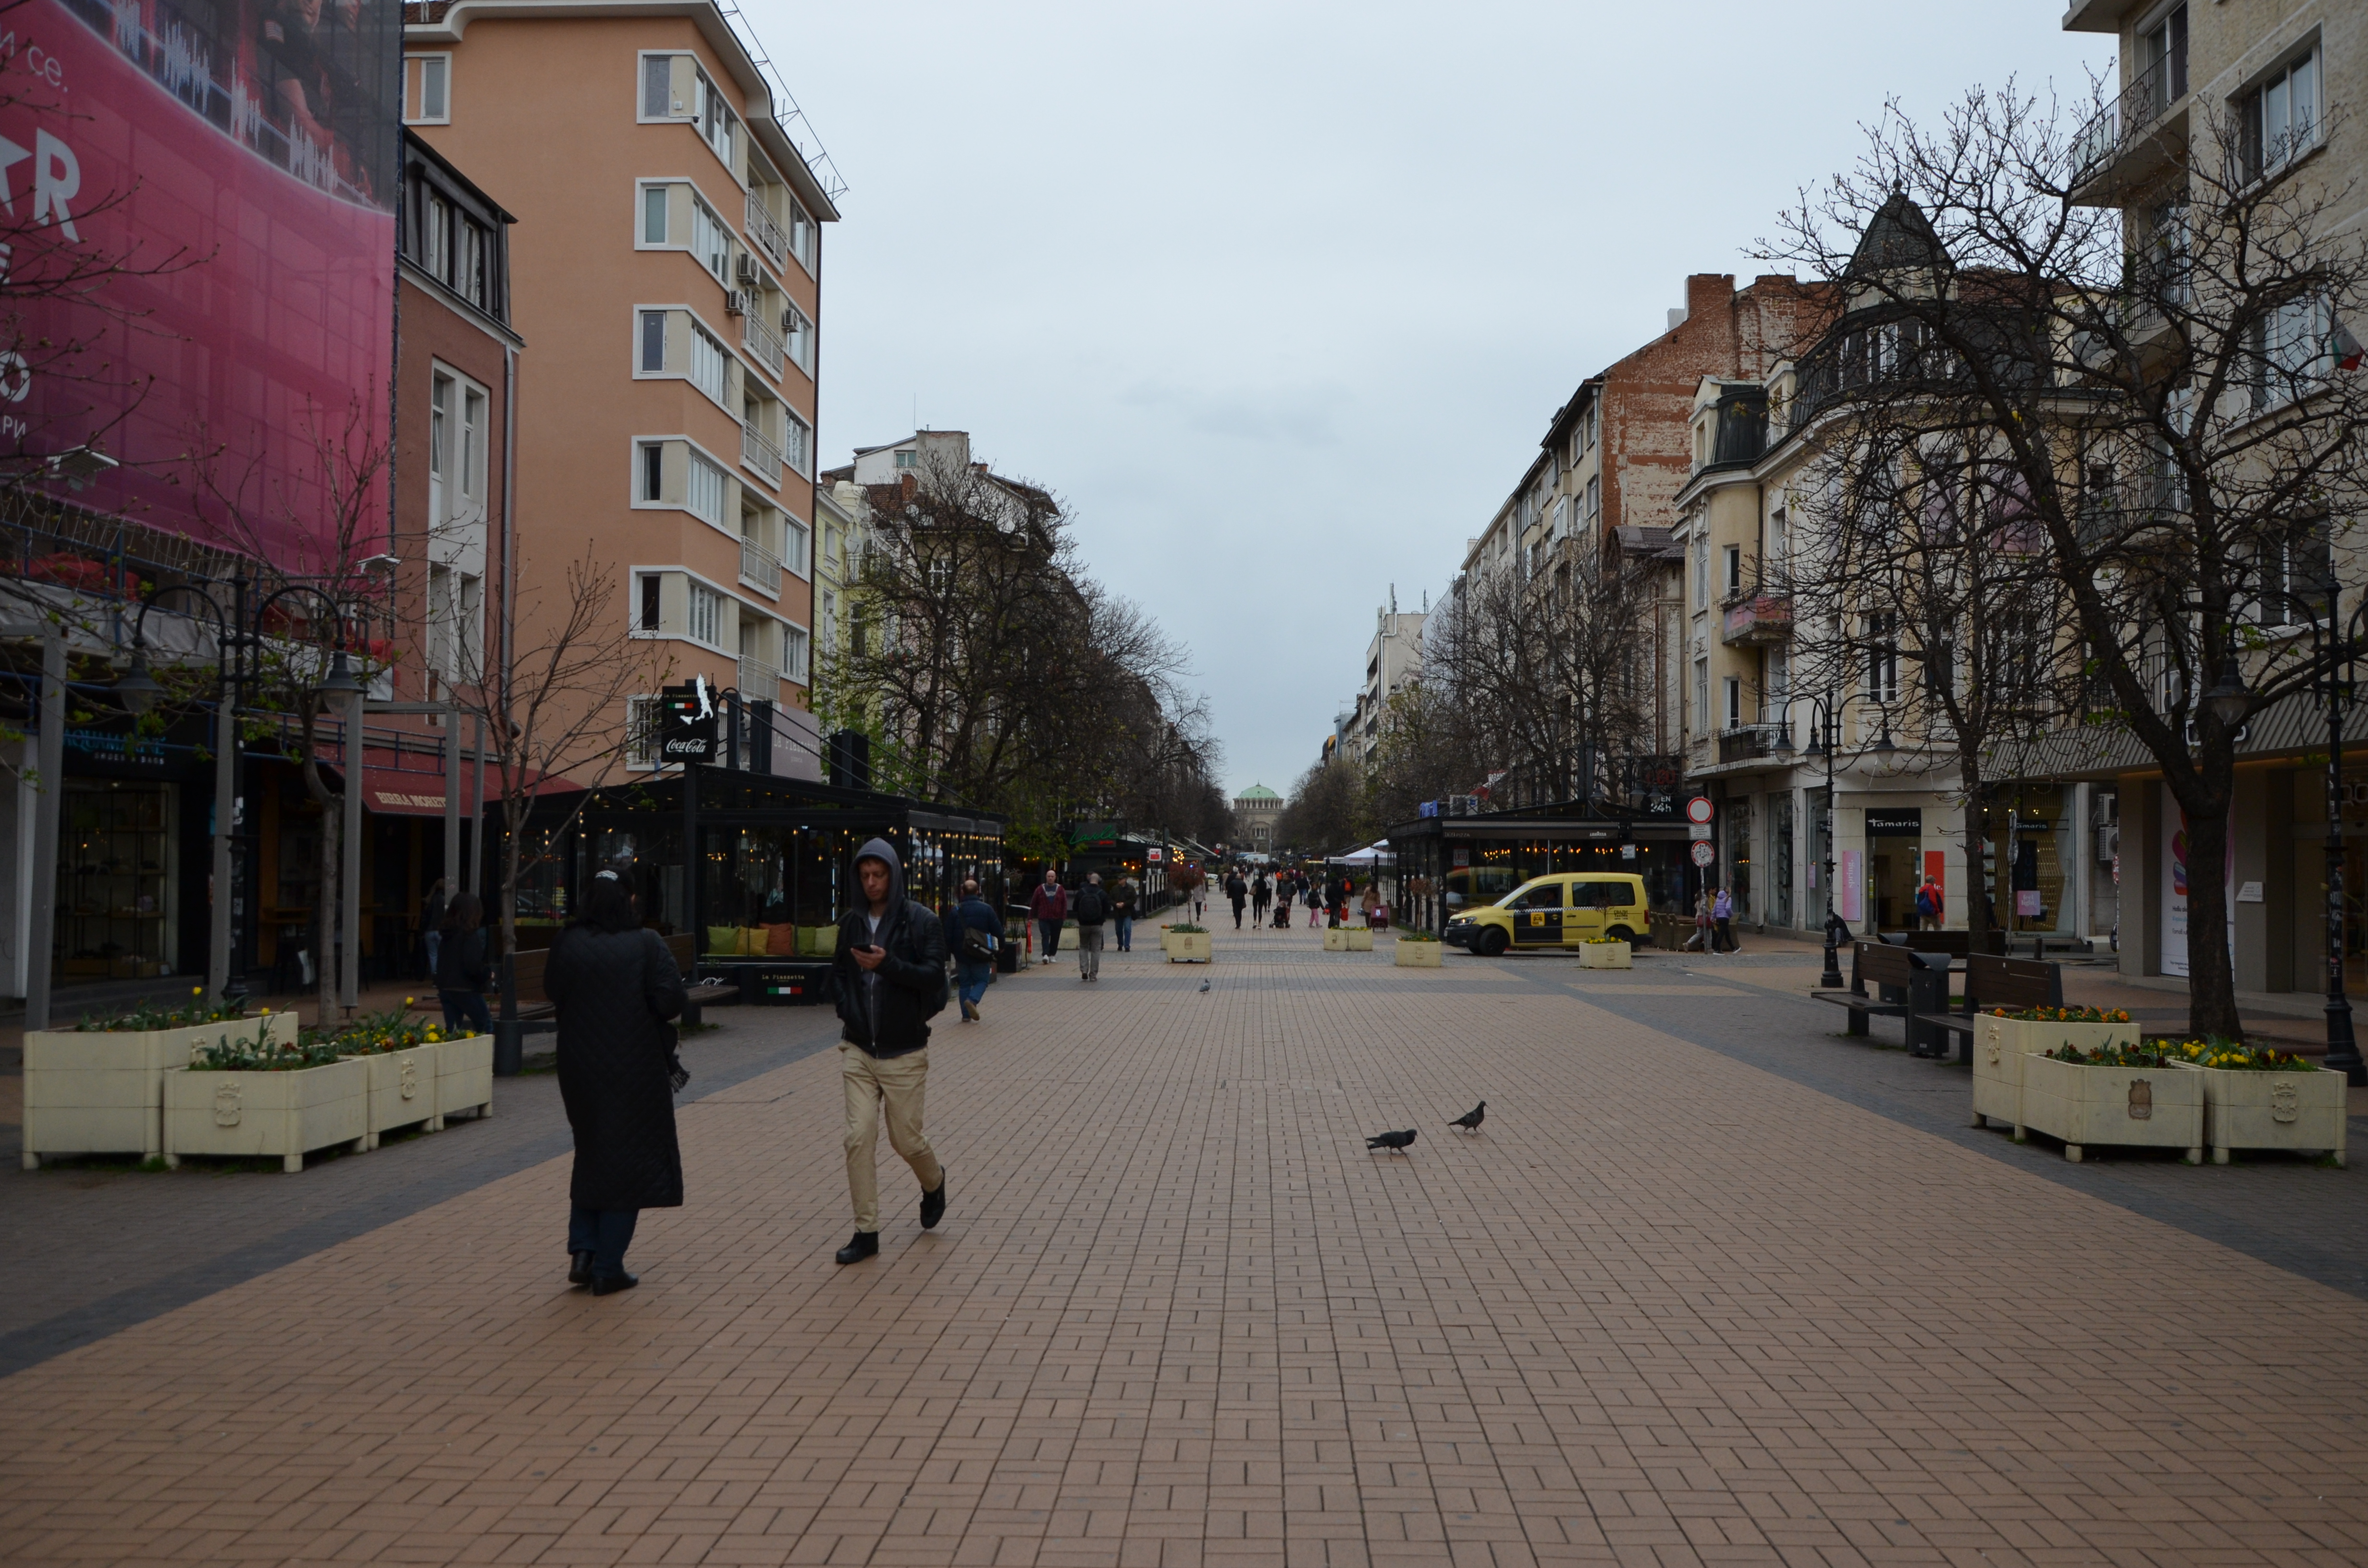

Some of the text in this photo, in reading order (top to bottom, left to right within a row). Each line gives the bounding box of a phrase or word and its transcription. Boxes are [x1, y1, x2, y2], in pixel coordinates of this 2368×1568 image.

[0, 415, 25, 438] РИ
[666, 738, 708, 753] Coca-Cola
[141, 756, 165, 765] BAGS
[374, 792, 446, 808] BIRRA MORET
[1651, 803, 1671, 812] 24h
[1847, 859, 1855, 888] spring.
